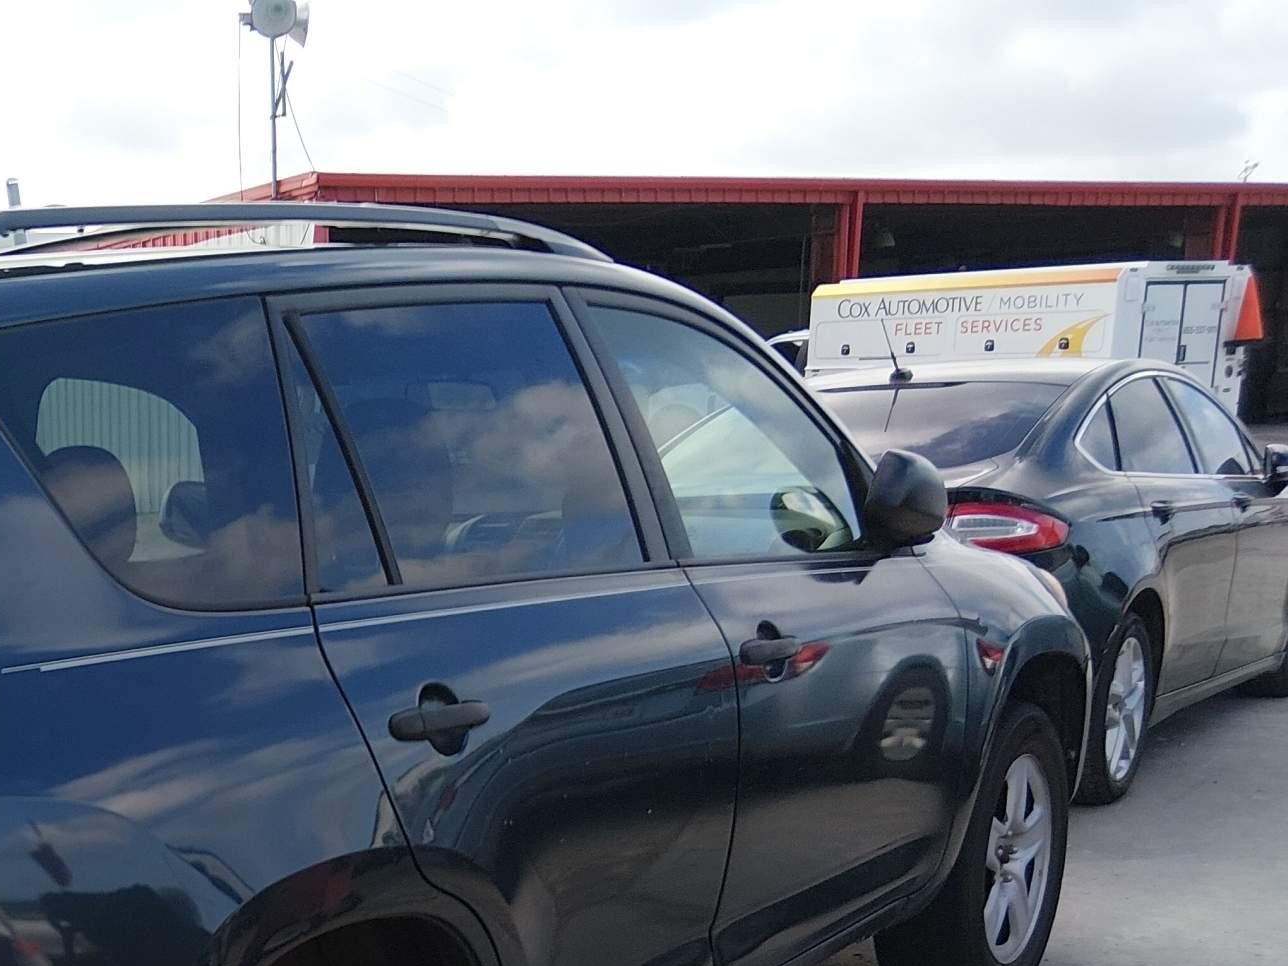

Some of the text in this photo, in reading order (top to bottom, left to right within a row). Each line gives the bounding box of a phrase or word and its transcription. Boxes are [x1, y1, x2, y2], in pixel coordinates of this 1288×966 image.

[999, 292, 1085, 310] MOBILITY
[894, 318, 1043, 336] FLEET SERVICES
